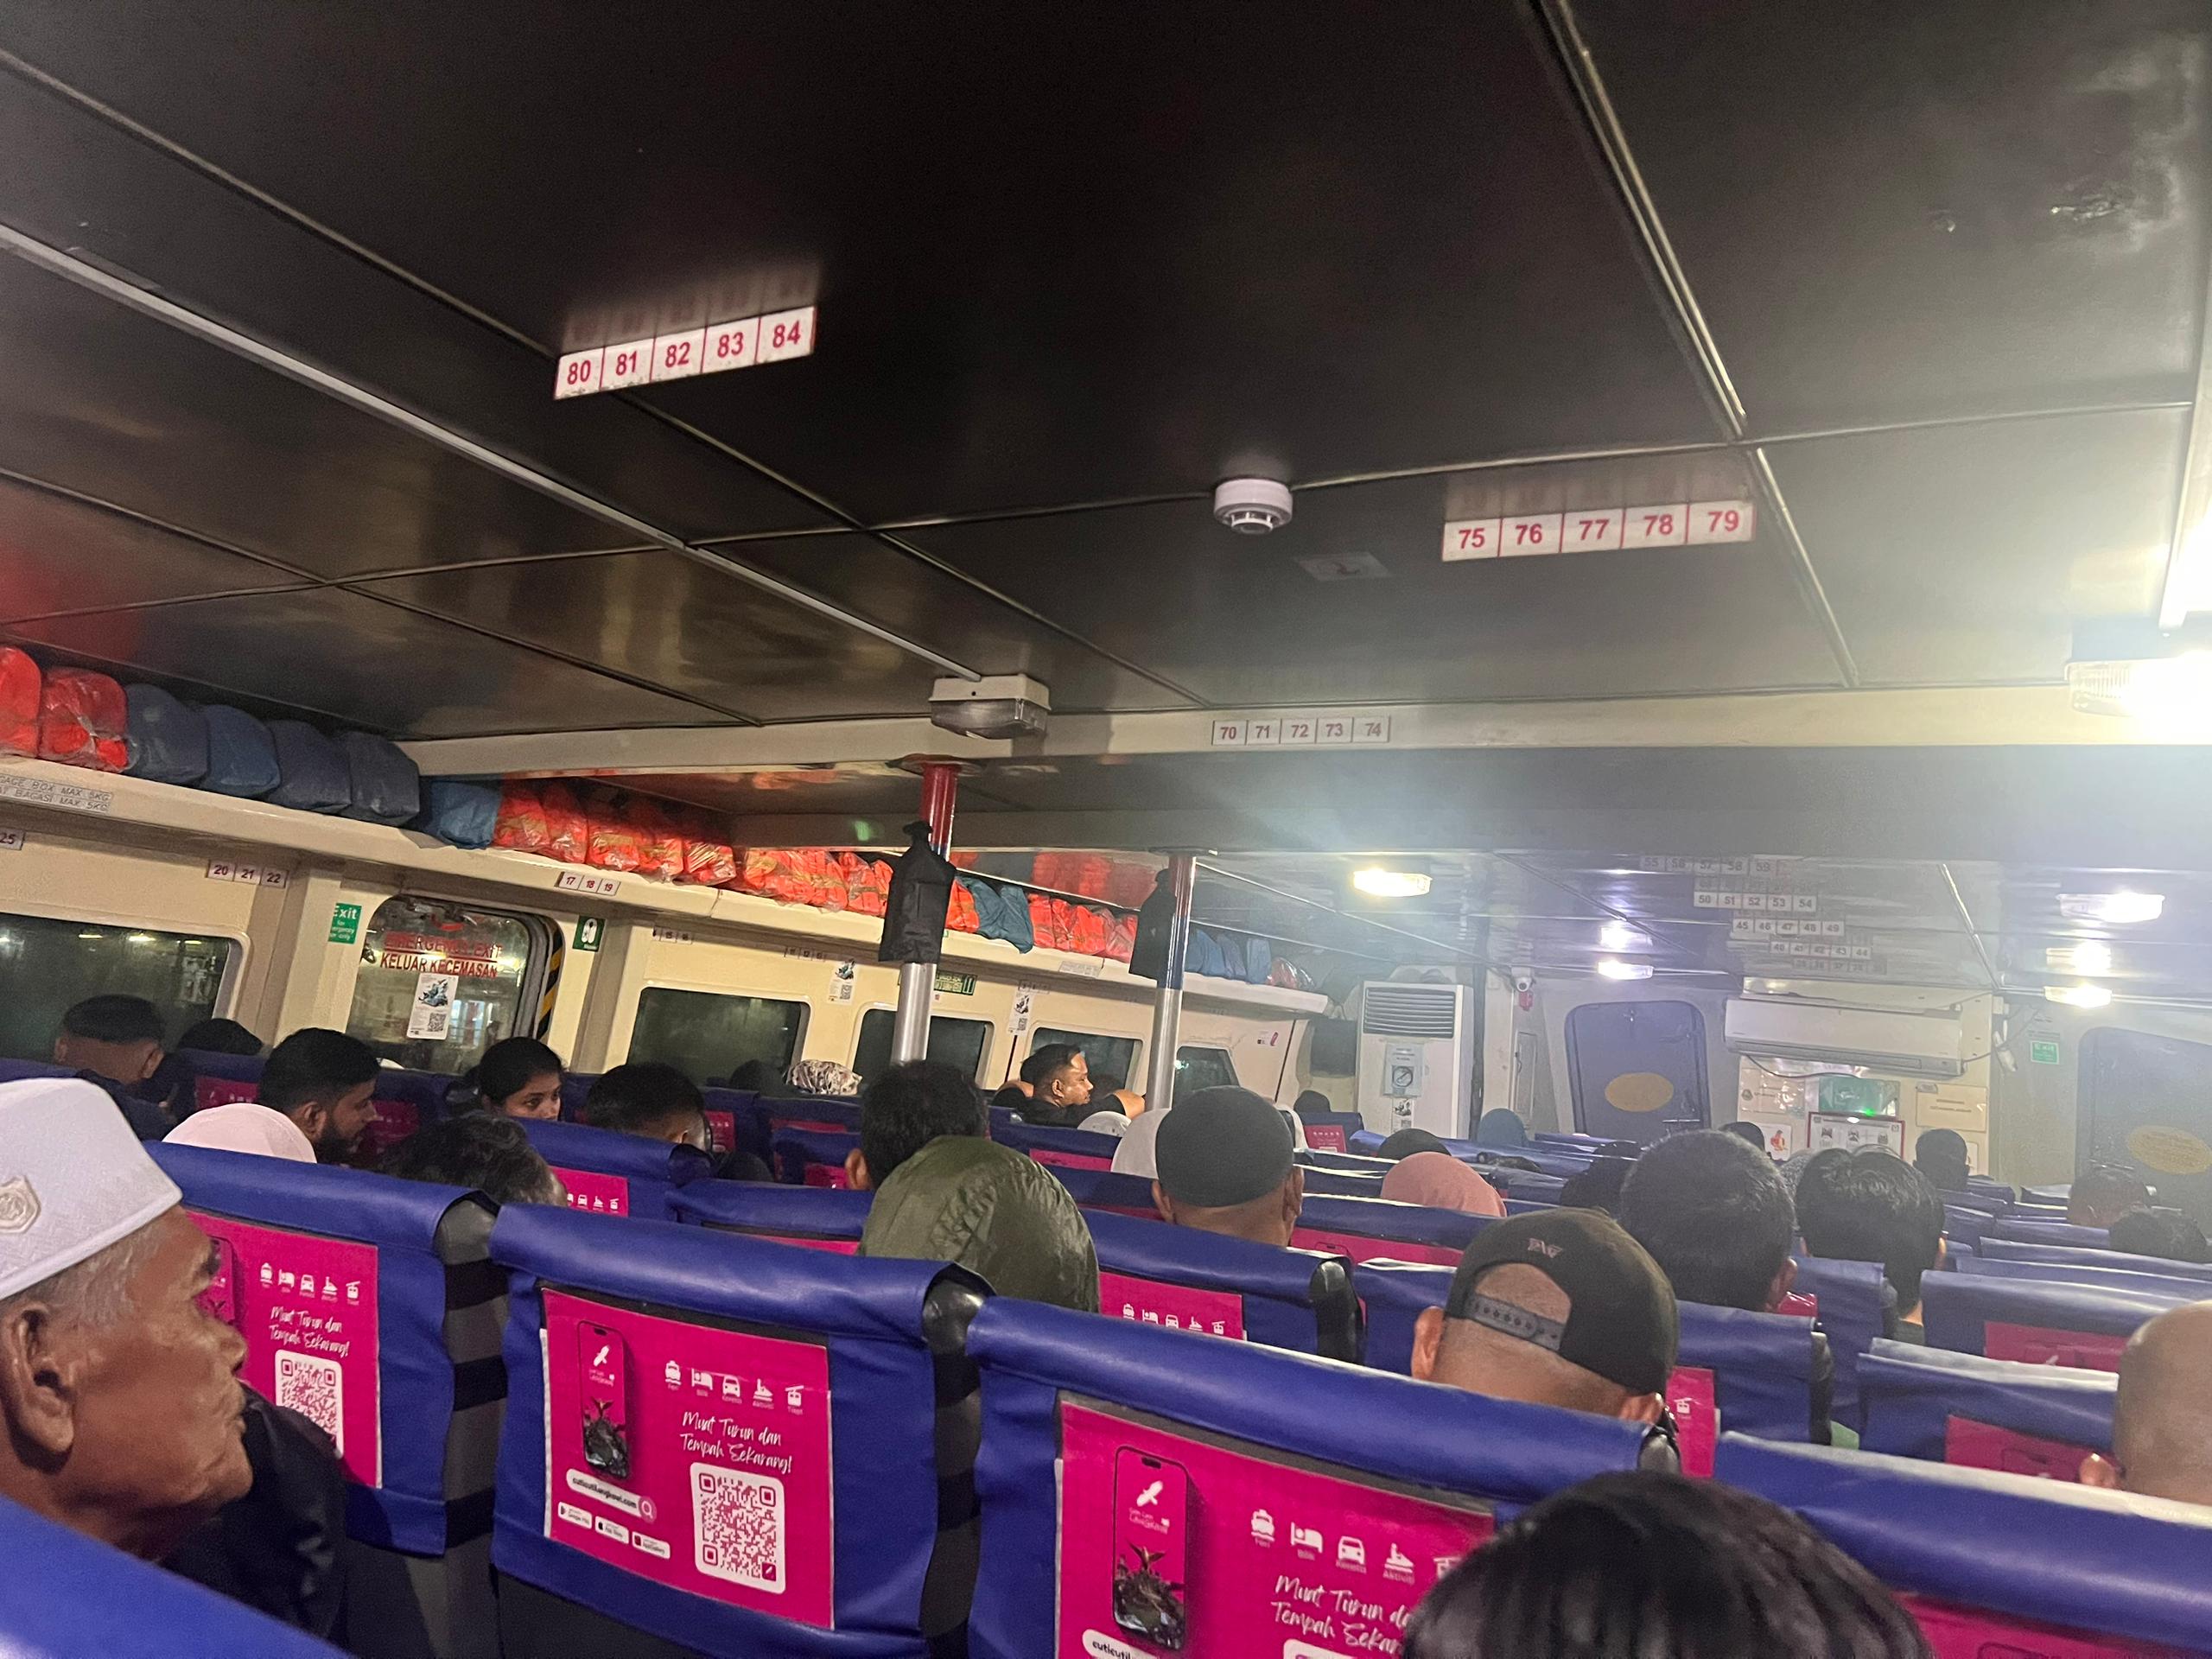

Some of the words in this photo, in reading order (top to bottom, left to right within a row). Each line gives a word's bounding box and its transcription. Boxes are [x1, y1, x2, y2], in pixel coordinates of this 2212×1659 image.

[567, 360, 591, 385] 80
[615, 351, 638, 376] 81
[664, 342, 690, 368] 82
[717, 332, 744, 358] 83
[773, 321, 801, 348] 84
[1458, 528, 1485, 550] 75
[1515, 524, 1542, 545] 76
[1579, 519, 1609, 540] 77
[1644, 514, 1673, 537] 78
[1708, 511, 1739, 532] 79
[1220, 727, 1236, 740] 70
[1255, 725, 1269, 738] 71
[1292, 724, 1309, 738] 72
[1325, 723, 1343, 737] 73
[1365, 722, 1382, 737] 74
[33, 780, 55, 792] BOX
[61, 787, 82, 797] MAX
[16, 789, 53, 803] BAGASI
[60, 797, 81, 807] MAX
[86, 801, 109, 812] 5KG
[0, 832, 16, 845] 25
[214, 865, 229, 876] 20
[241, 869, 255, 880] 21
[267, 873, 282, 884] 22
[566, 876, 576, 886] 17
[605, 883, 613, 892] 19
[1699, 894, 1712, 904] 50
[1725, 896, 1735, 906] 51
[1748, 897, 1760, 906] 52
[1772, 898, 1786, 907] 53
[1799, 899, 1813, 908] 54
[334, 905, 357, 919] Exit
[1736, 921, 1749, 931] 45
[1781, 922, 1794, 931] 47
[1827, 924, 1840, 933] 49
[380, 951, 427, 973] KELUAR
[429, 957, 499, 979] KECEMASAN
[719, 1418, 754, 1441] Turun
[758, 1427, 781, 1446] dan
[680, 1433, 724, 1458] Tempah
[727, 1443, 792, 1475] Sekarang!
[1330, 1590, 1383, 1621] Turun
[1270, 1601, 1336, 1639] Tempah
